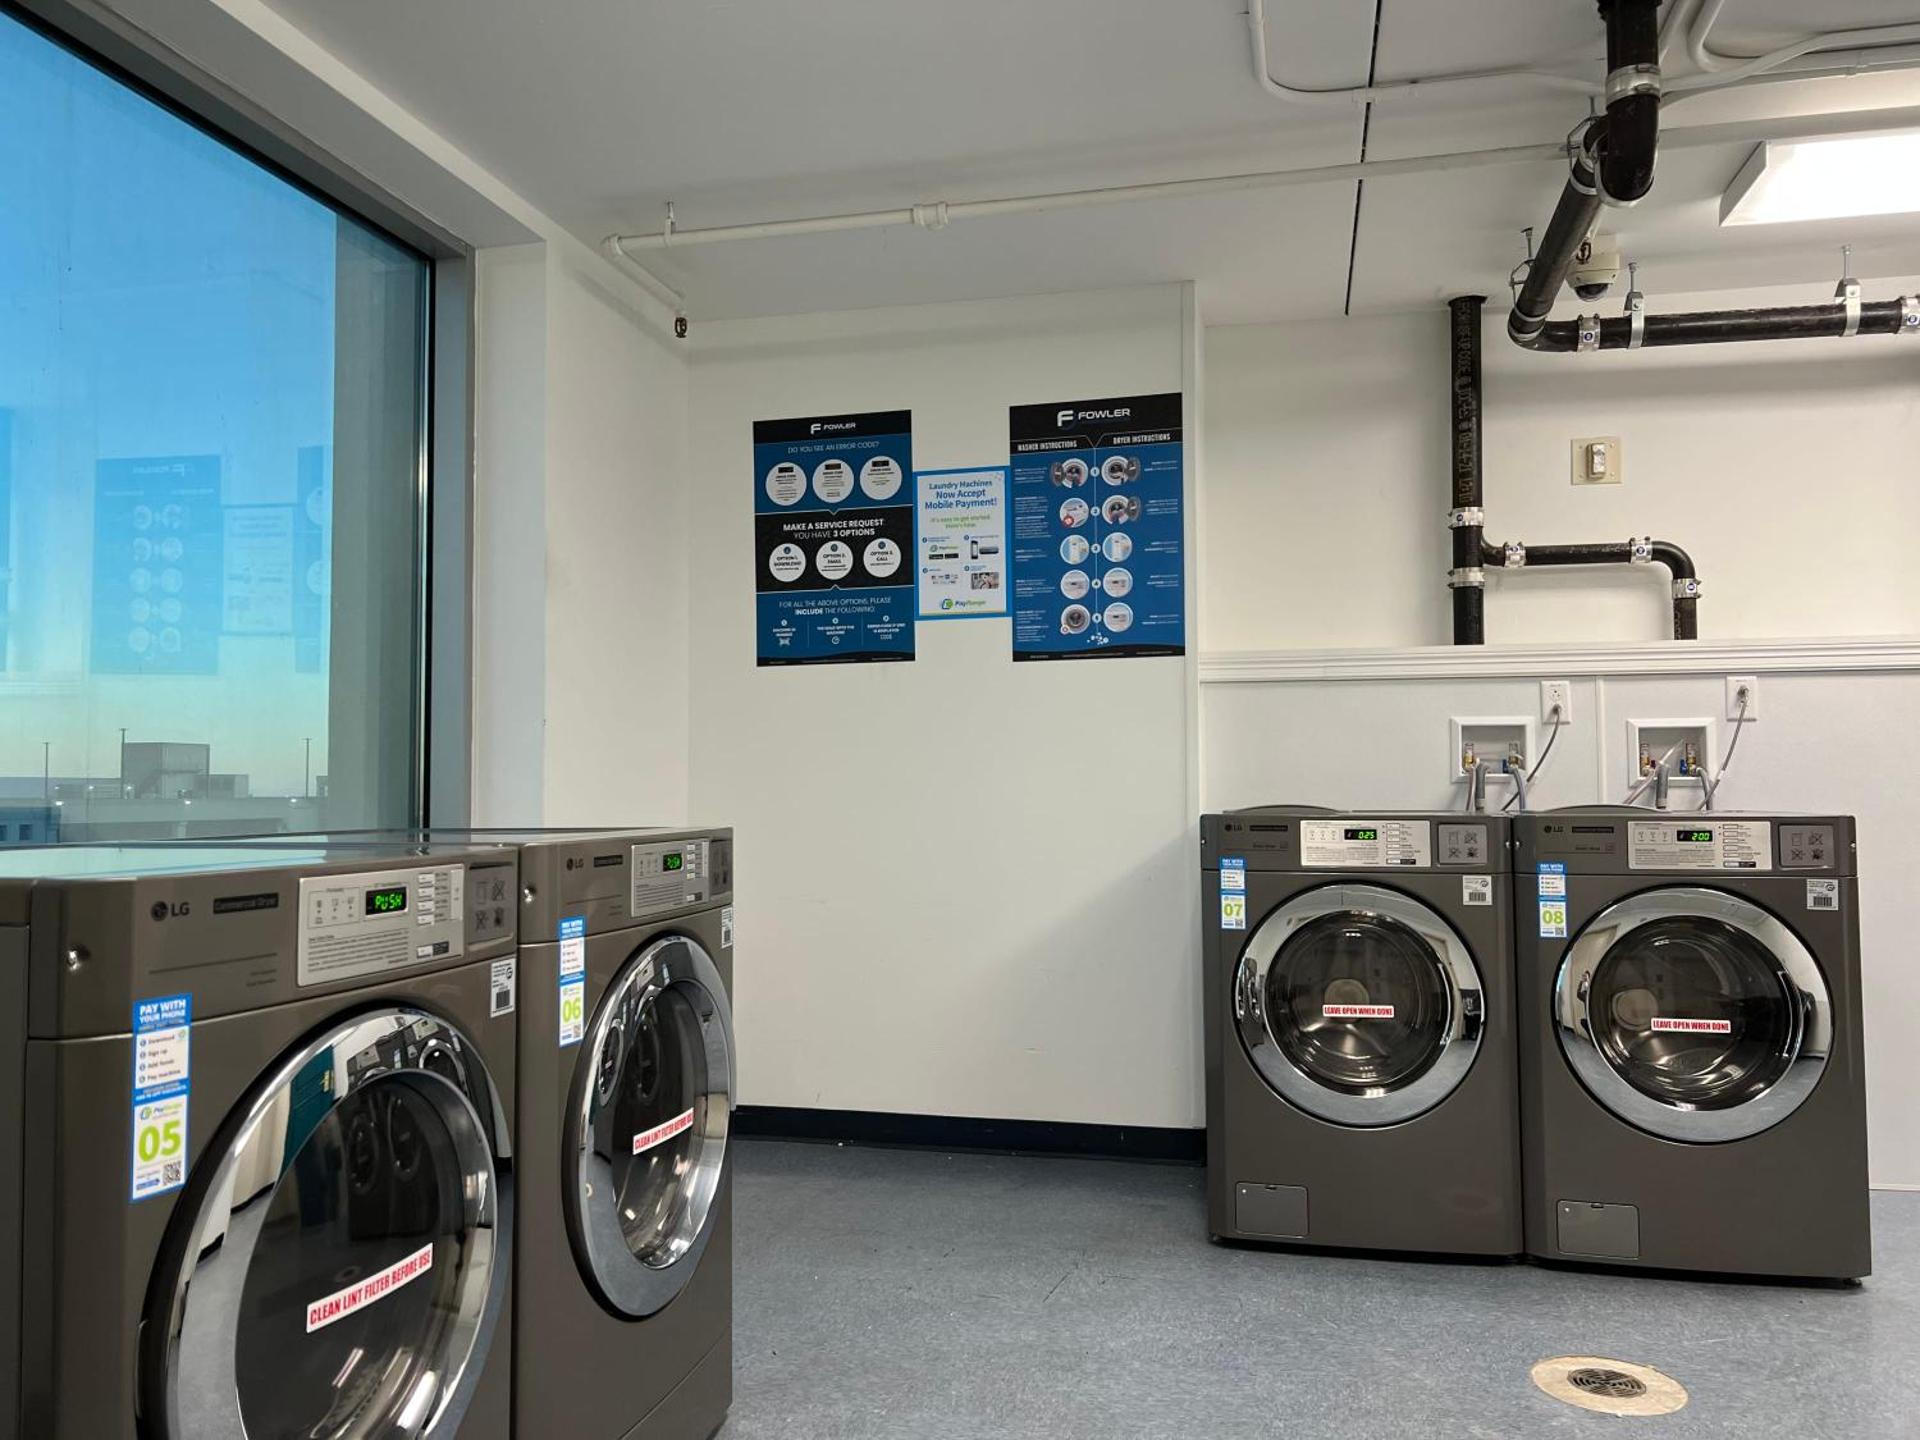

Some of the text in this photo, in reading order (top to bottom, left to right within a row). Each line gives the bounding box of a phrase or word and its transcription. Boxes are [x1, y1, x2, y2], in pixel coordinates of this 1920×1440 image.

[1078, 408, 1131, 420] FOWLER
[823, 422, 856, 431] FOWLER
[1113, 433, 1171, 445] DRYER INSTRUCTIONS
[799, 445, 813, 453] YOU
[836, 442, 856, 450] ERROR
[1017, 440, 1077, 451] WASHER INSTRUCTIONS
[929, 480, 993, 490] Laundry Machines
[936, 489, 986, 499] Now Accept
[925, 497, 997, 509] Mobile Payment!
[783, 518, 884, 531] MAKE A SERVICE REQUEST
[793, 531, 810, 540] YOU
[811, 530, 832, 538] HAVE
[839, 528, 875, 537] OPTIONS
[817, 599, 838, 607] ABOVE
[870, 596, 891, 604] PLEASE
[794, 608, 824, 616] INCLUDE
[375, 894, 403, 910] PUSH
[171, 902, 190, 917] LG
[1224, 903, 1243, 917] 07
[1542, 910, 1564, 924] 08
[139, 999, 187, 1017] PAY WITH
[563, 997, 581, 1023] 06
[1324, 1006, 1341, 1015] LEAVE
[1342, 1006, 1357, 1015] OPEN
[1358, 1007, 1376, 1015] WHEN
[1653, 1020, 1729, 1031] LEAVE OPEN WHEN DONE
[138, 1120, 181, 1162] 05
[635, 1135, 650, 1150] CLEAN
[651, 1130, 661, 1143] LINT
[662, 1123, 674, 1139] FILTER
[310, 1250, 431, 1325] CLEAN LINT FILTER BEFORE USE
